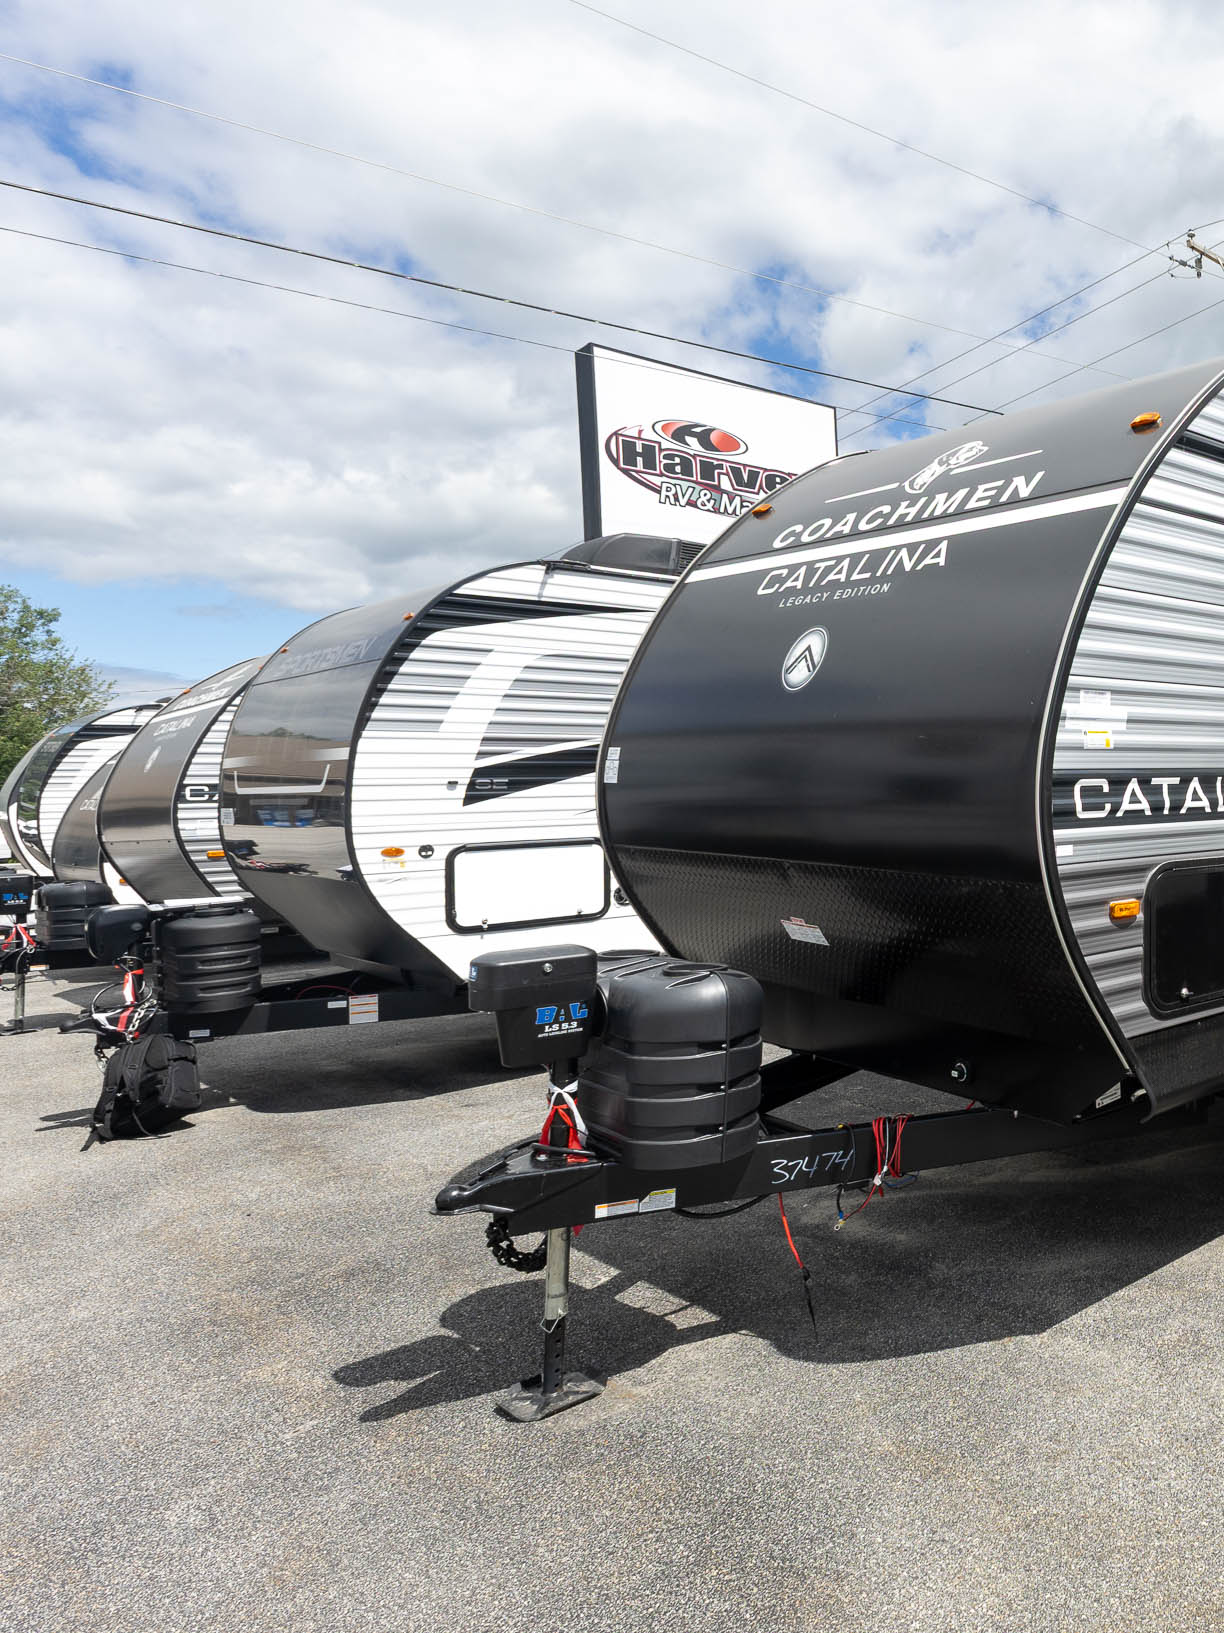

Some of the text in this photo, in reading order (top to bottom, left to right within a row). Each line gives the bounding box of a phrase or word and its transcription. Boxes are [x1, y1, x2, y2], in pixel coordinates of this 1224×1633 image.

[619, 437, 793, 494] Harve
[660, 481, 694, 508] RV
[697, 489, 716, 513] &
[772, 471, 1046, 549] COACHMEN
[757, 540, 949, 595] CATALINA
[779, 582, 892, 608] LEGACY EDITION
[770, 1149, 855, 1184] 37474
